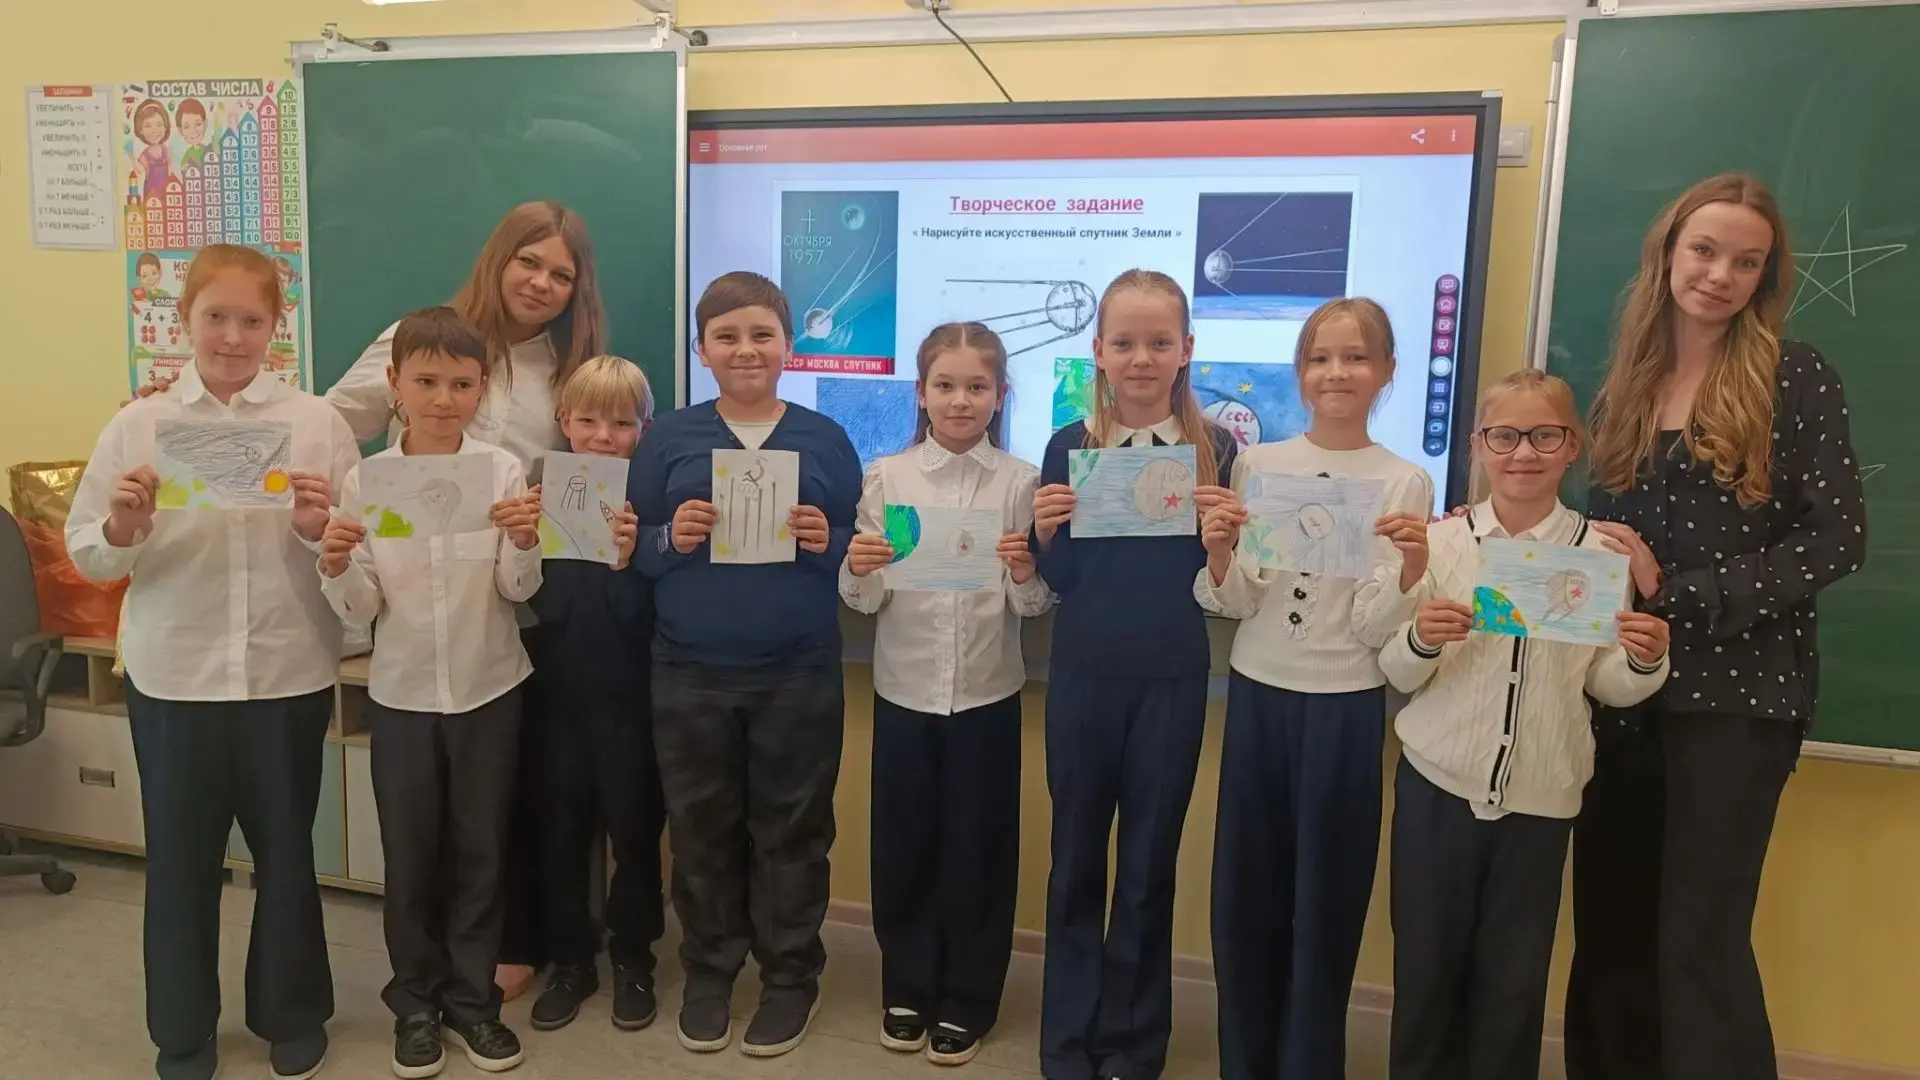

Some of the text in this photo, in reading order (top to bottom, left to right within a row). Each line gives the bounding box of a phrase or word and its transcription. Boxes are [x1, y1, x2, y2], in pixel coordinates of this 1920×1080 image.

[152, 82, 206, 96] СОСТАВ
[211, 82, 260, 95] ЧИСЛА
[950, 196, 1144, 215] Творческое задание
[783, 234, 832, 246] ОКТЯБРЯ
[922, 226, 1172, 240] Нарисуйте искусственный спутник Земли
[789, 248, 824, 265] 1957
[144, 312, 152, 322] 4
[171, 312, 178, 324] 3
[808, 360, 840, 370] МОСКВА
[844, 360, 882, 370] СПУТНИК
